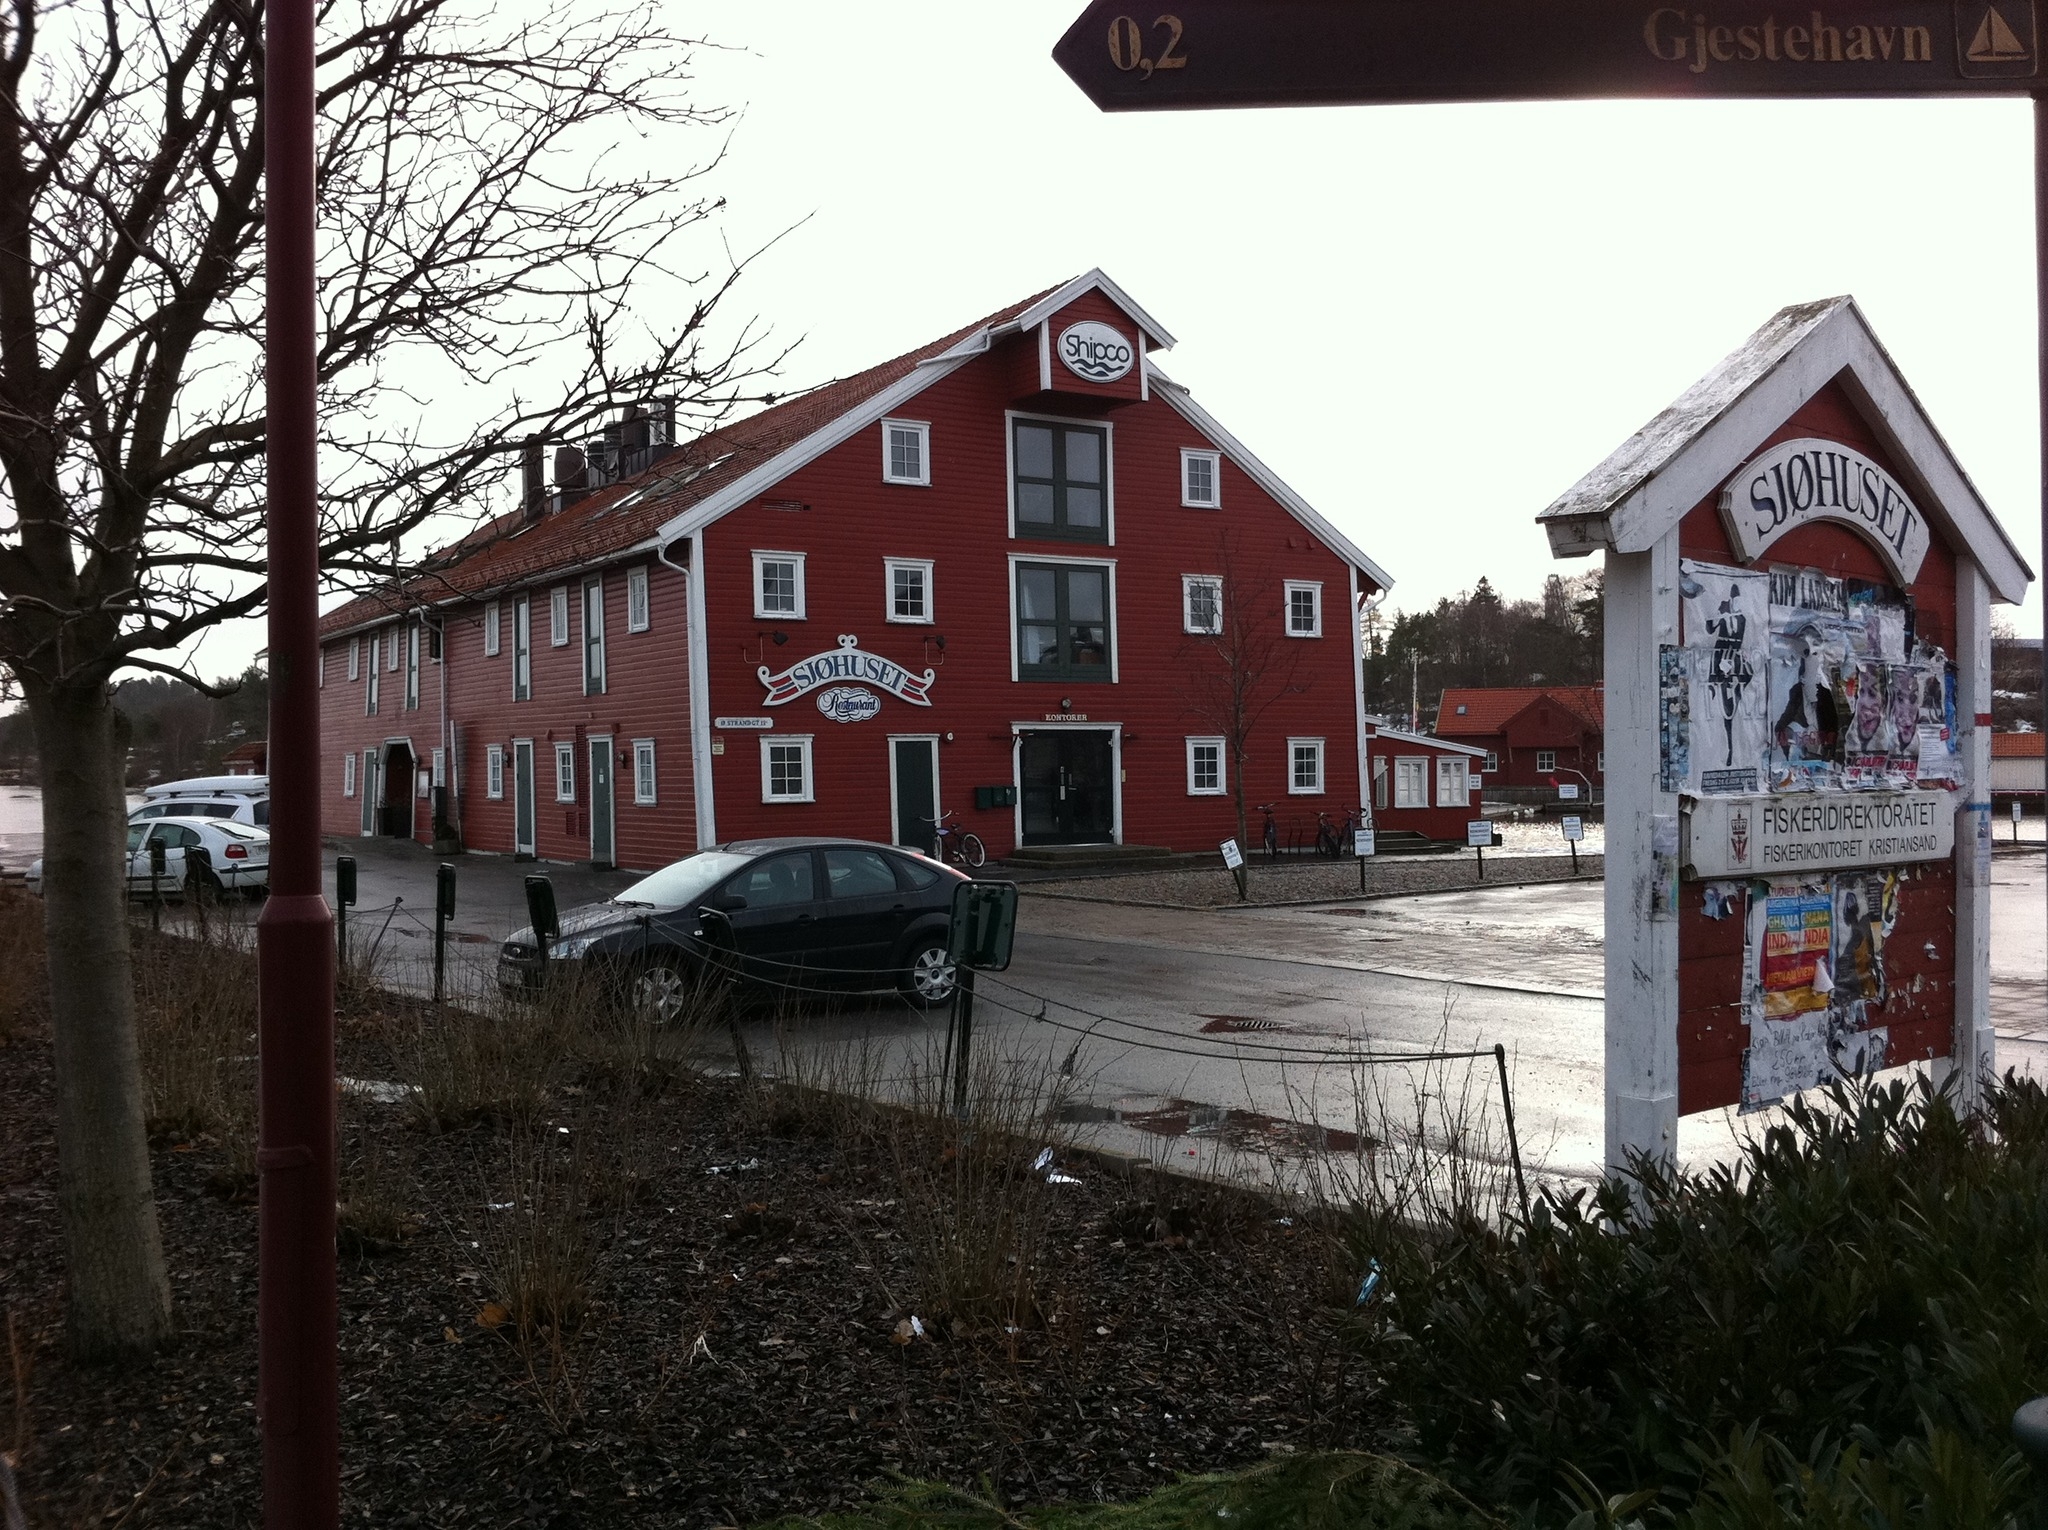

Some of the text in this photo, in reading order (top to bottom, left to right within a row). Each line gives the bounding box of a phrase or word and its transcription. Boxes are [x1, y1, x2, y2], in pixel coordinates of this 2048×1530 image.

[1108, 7, 1932, 81] 0,2 Gjestehavn
[1066, 334, 1130, 364] Shipco
[1750, 450, 1917, 560] SJØHUSET
[1769, 573, 1796, 607] KIM
[793, 655, 907, 691] SJØHUSET
[819, 692, 877, 714] Restaurant
[1045, 713, 1088, 721] KONTORER
[1763, 801, 1937, 835] FISKERIDIREKTORATET
[1763, 835, 1938, 863] FISKERIKONTORET KRISTIANSAND
[1768, 914, 1799, 930] GHANA
[1801, 910, 1829, 926] GHANA
[1804, 928, 1828, 946] NDIA
